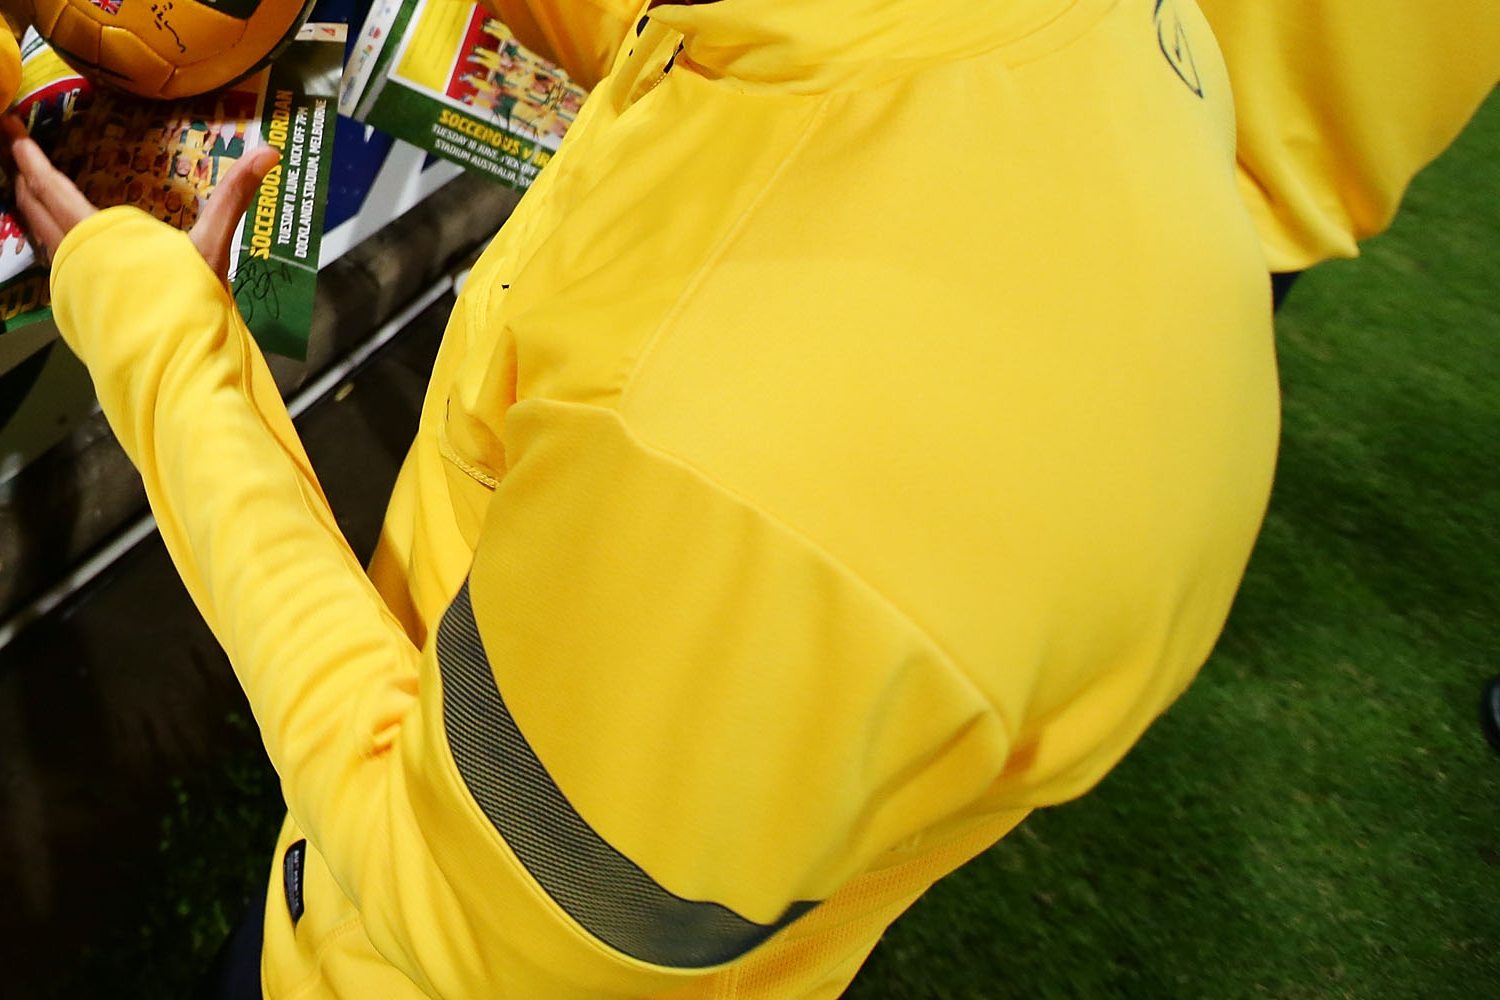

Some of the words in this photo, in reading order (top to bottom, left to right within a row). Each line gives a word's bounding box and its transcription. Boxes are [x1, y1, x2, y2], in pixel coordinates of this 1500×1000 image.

[267, 90, 293, 150] JORDAN
[293, 125, 306, 143] OFF
[432, 123, 468, 147] TUESDAY
[439, 109, 522, 157] SOCCEROOS
[290, 142, 303, 166] KICK
[435, 139, 470, 164] STADIUM
[295, 199, 314, 259] DOCKLANDS
[309, 99, 327, 154] MELBOURNE
[277, 204, 295, 245] TUESDAY
